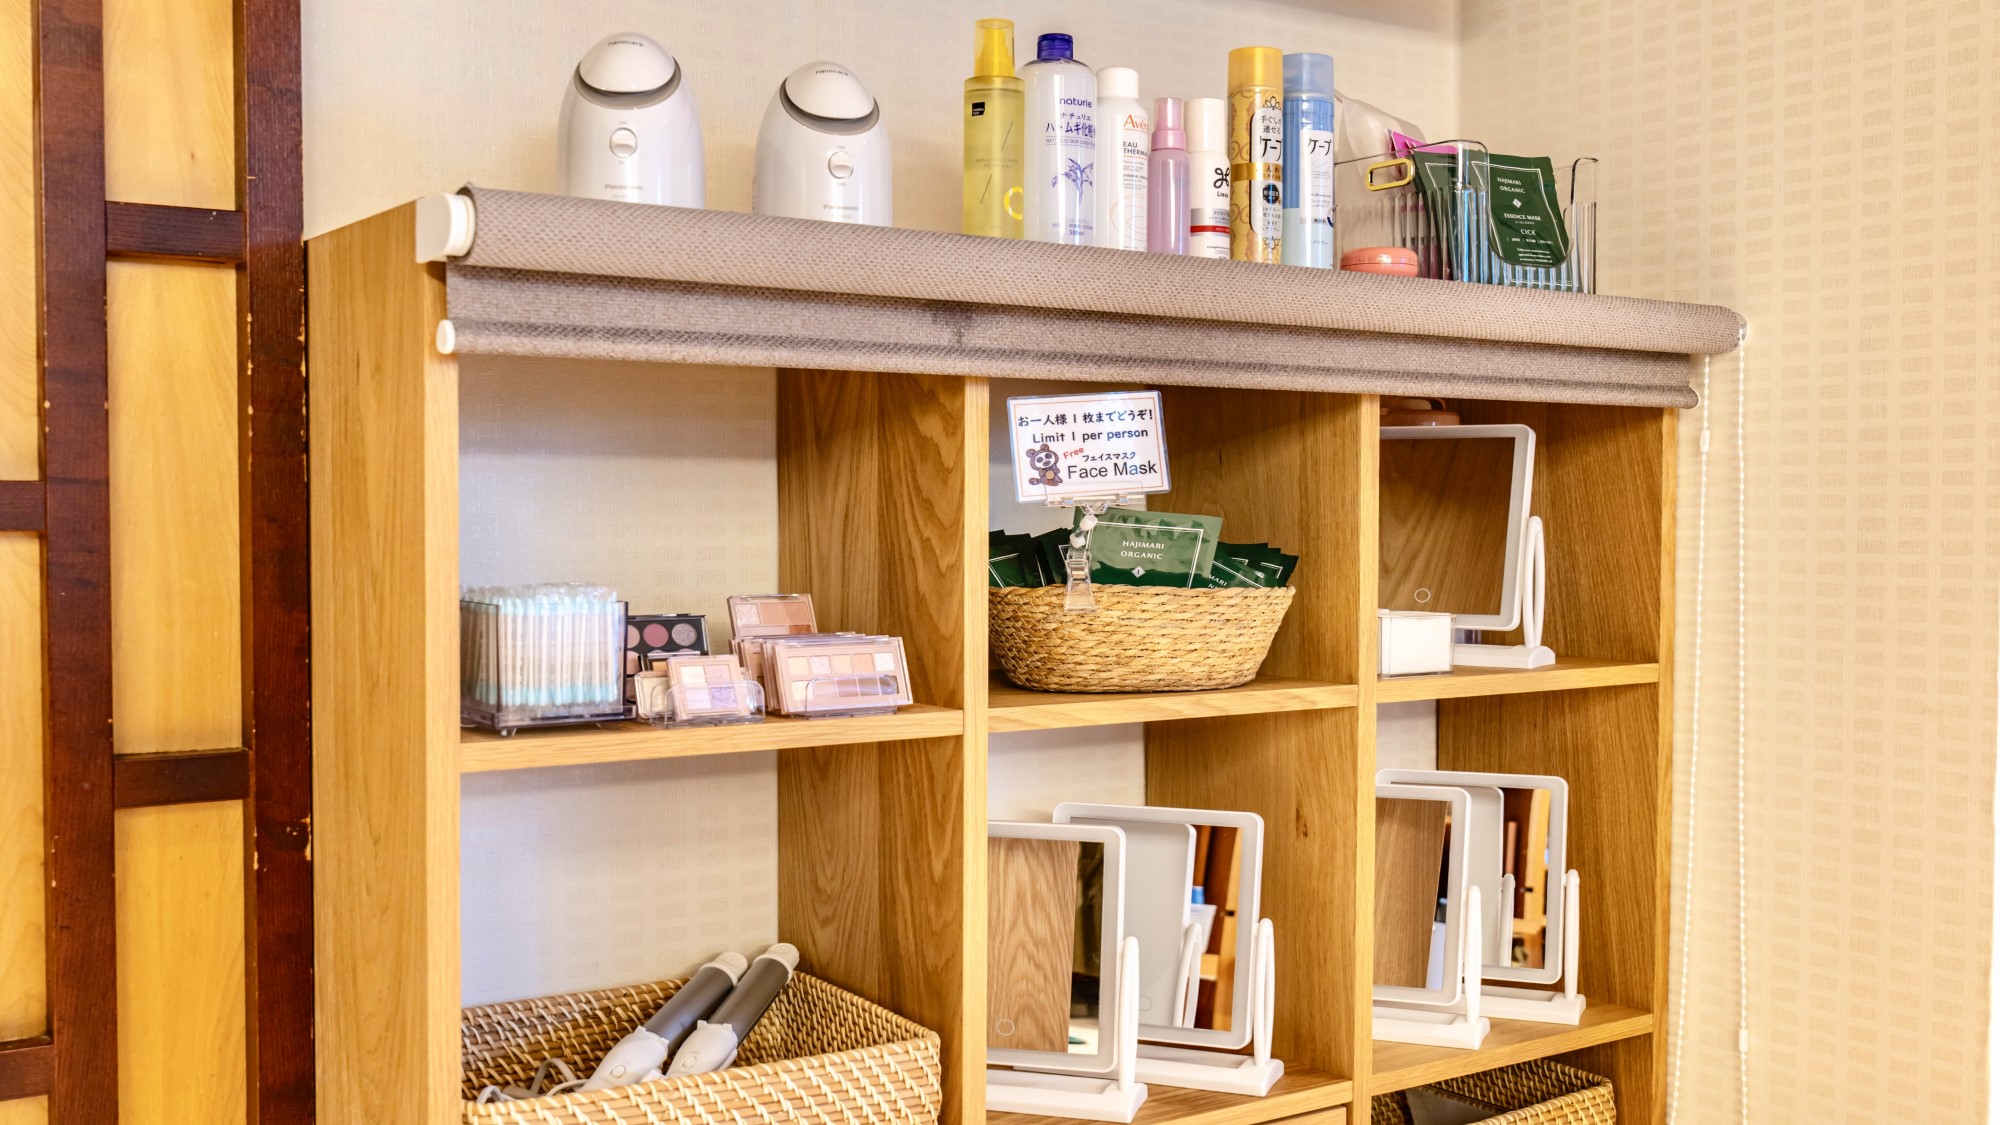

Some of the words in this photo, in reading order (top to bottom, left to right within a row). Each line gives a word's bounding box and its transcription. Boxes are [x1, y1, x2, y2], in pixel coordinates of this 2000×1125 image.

[1059, 98, 1093, 108] naturie
[1060, 112, 1091, 121] ナチュリエ
[1123, 141, 1138, 149] EAU
[823, 204, 859, 212] Pansonic
[1032, 432, 1065, 444] Limit
[1082, 431, 1103, 443] per
[1107, 429, 1149, 441] person
[1062, 447, 1084, 460] Free
[1081, 451, 1136, 463] フェイスマスク
[1067, 465, 1108, 480] Face
[1113, 460, 1158, 477] Mask
[1122, 540, 1165, 549] HAJIMARI
[1120, 550, 1164, 560] ORGANIC
